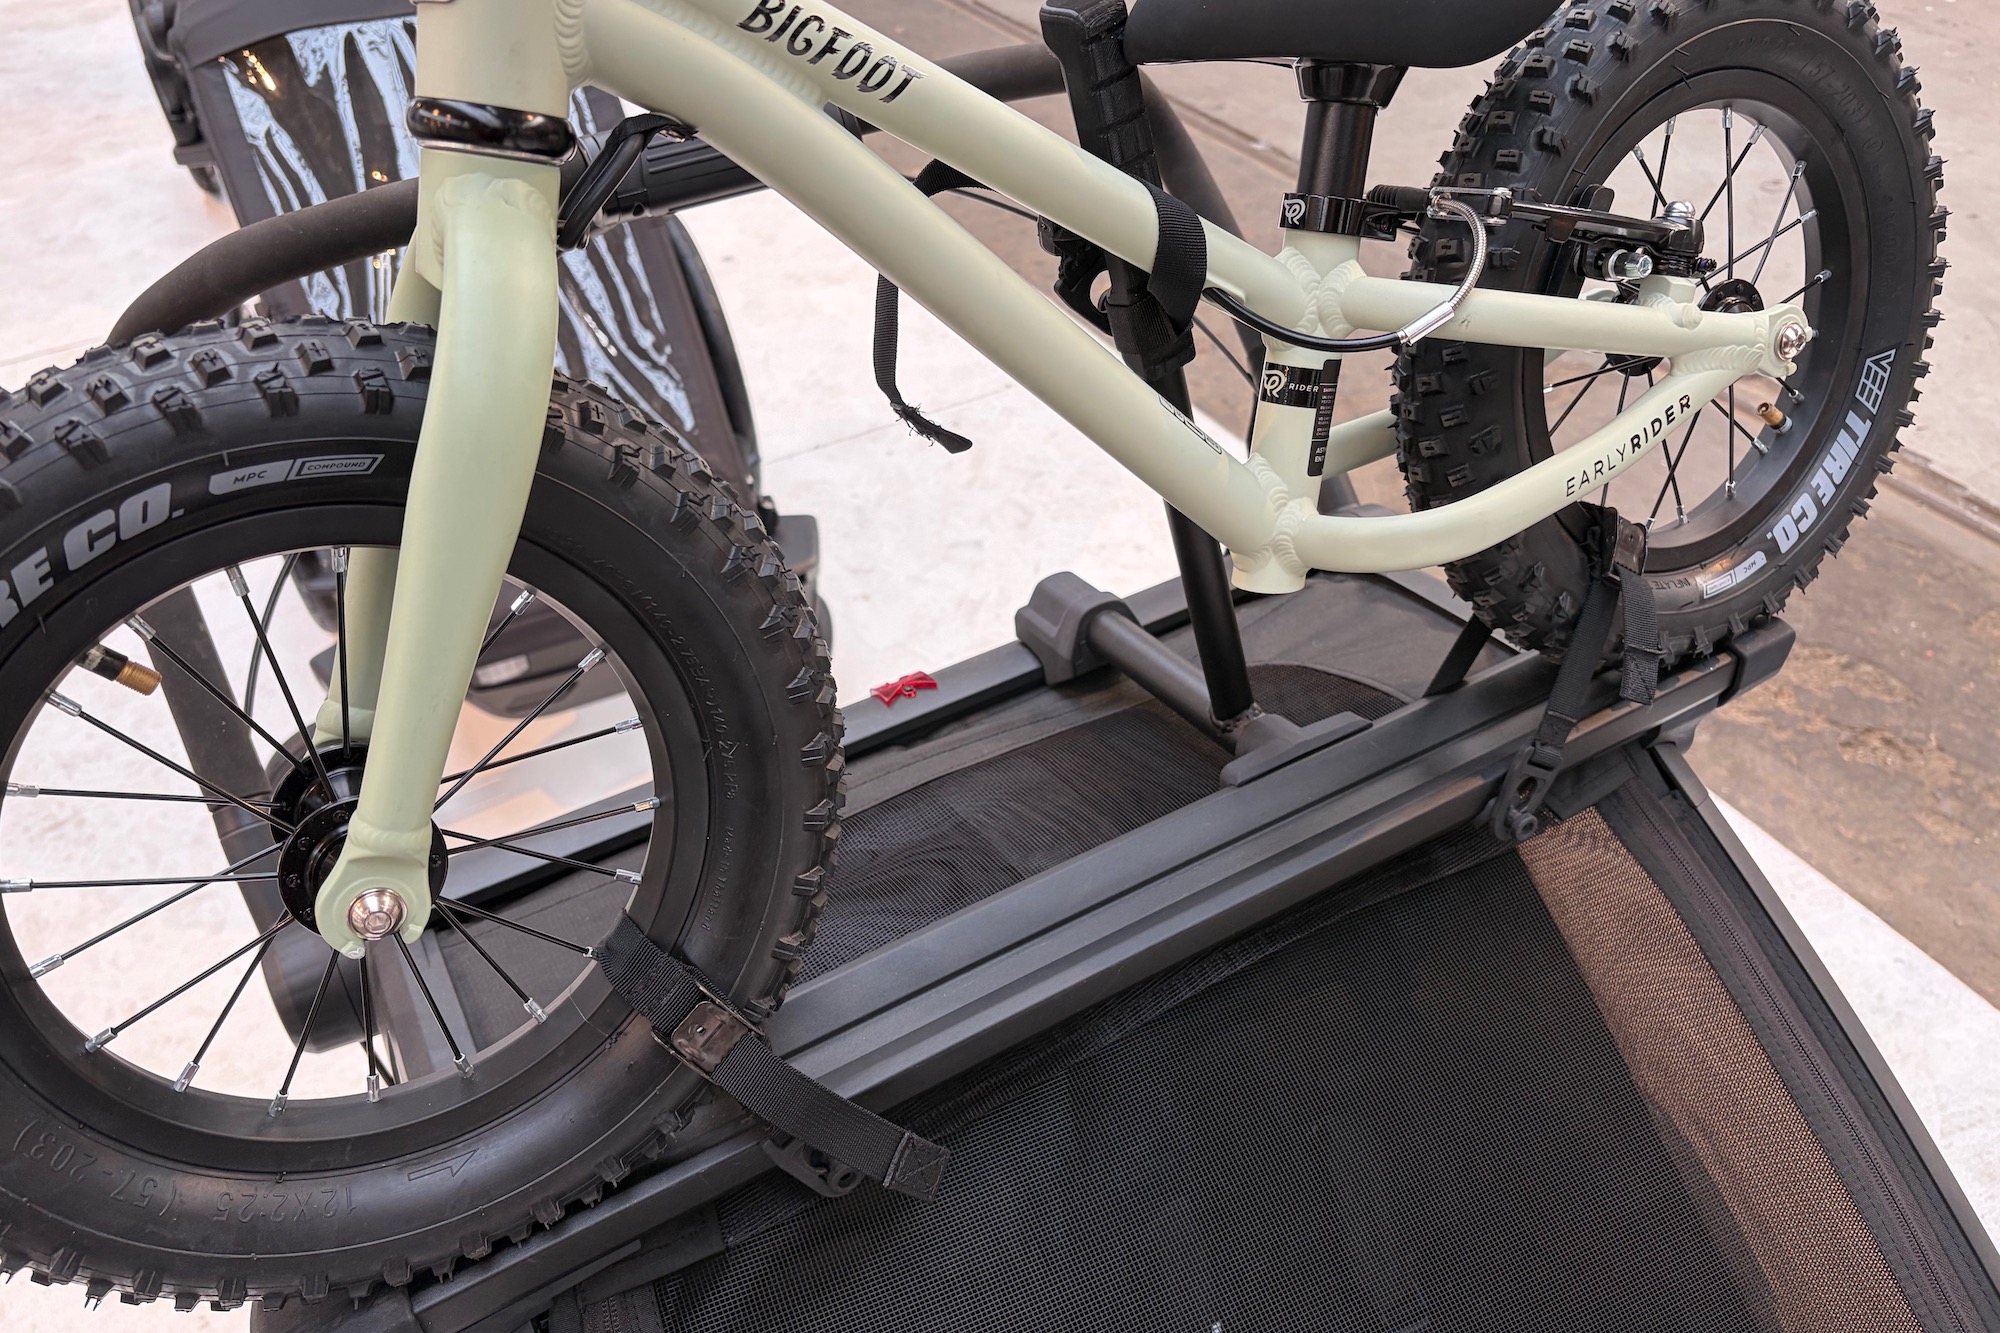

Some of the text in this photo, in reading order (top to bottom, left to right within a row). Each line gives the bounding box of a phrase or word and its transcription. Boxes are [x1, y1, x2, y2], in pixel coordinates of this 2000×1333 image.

[736, 0, 928, 104] BIGFOOT
[1289, 383, 1319, 393] RIDER
[1766, 349, 1896, 554] VEE TIRE CO.
[63, 482, 185, 571] CO.
[233, 470, 267, 484] MPC
[307, 461, 366, 471] COMPOUND
[1652, 577, 1691, 590] INFLATE
